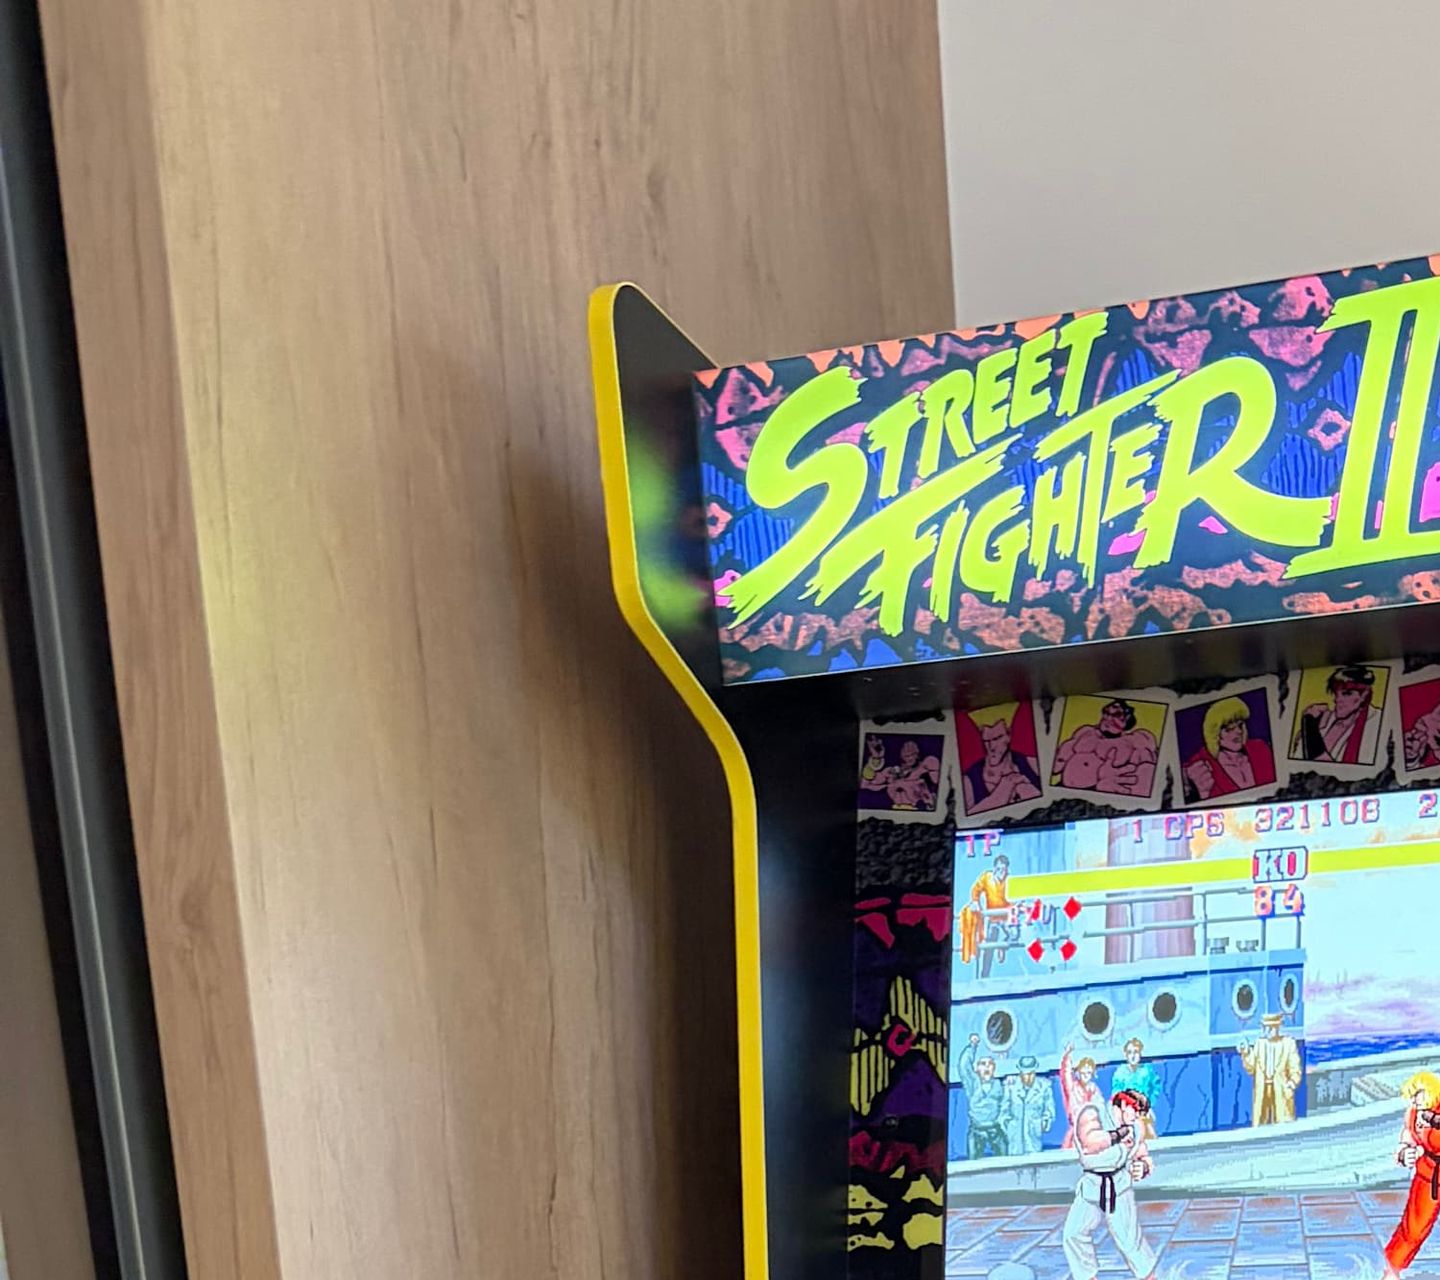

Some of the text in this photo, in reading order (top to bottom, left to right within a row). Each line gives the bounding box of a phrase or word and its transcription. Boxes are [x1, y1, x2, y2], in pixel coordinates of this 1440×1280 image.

[720, 312, 1109, 630] STREET
[802, 356, 1332, 636] FIGHTER
[965, 832, 1000, 858] 1P
[1253, 846, 1308, 883] KO
[1254, 884, 1305, 918] 84
